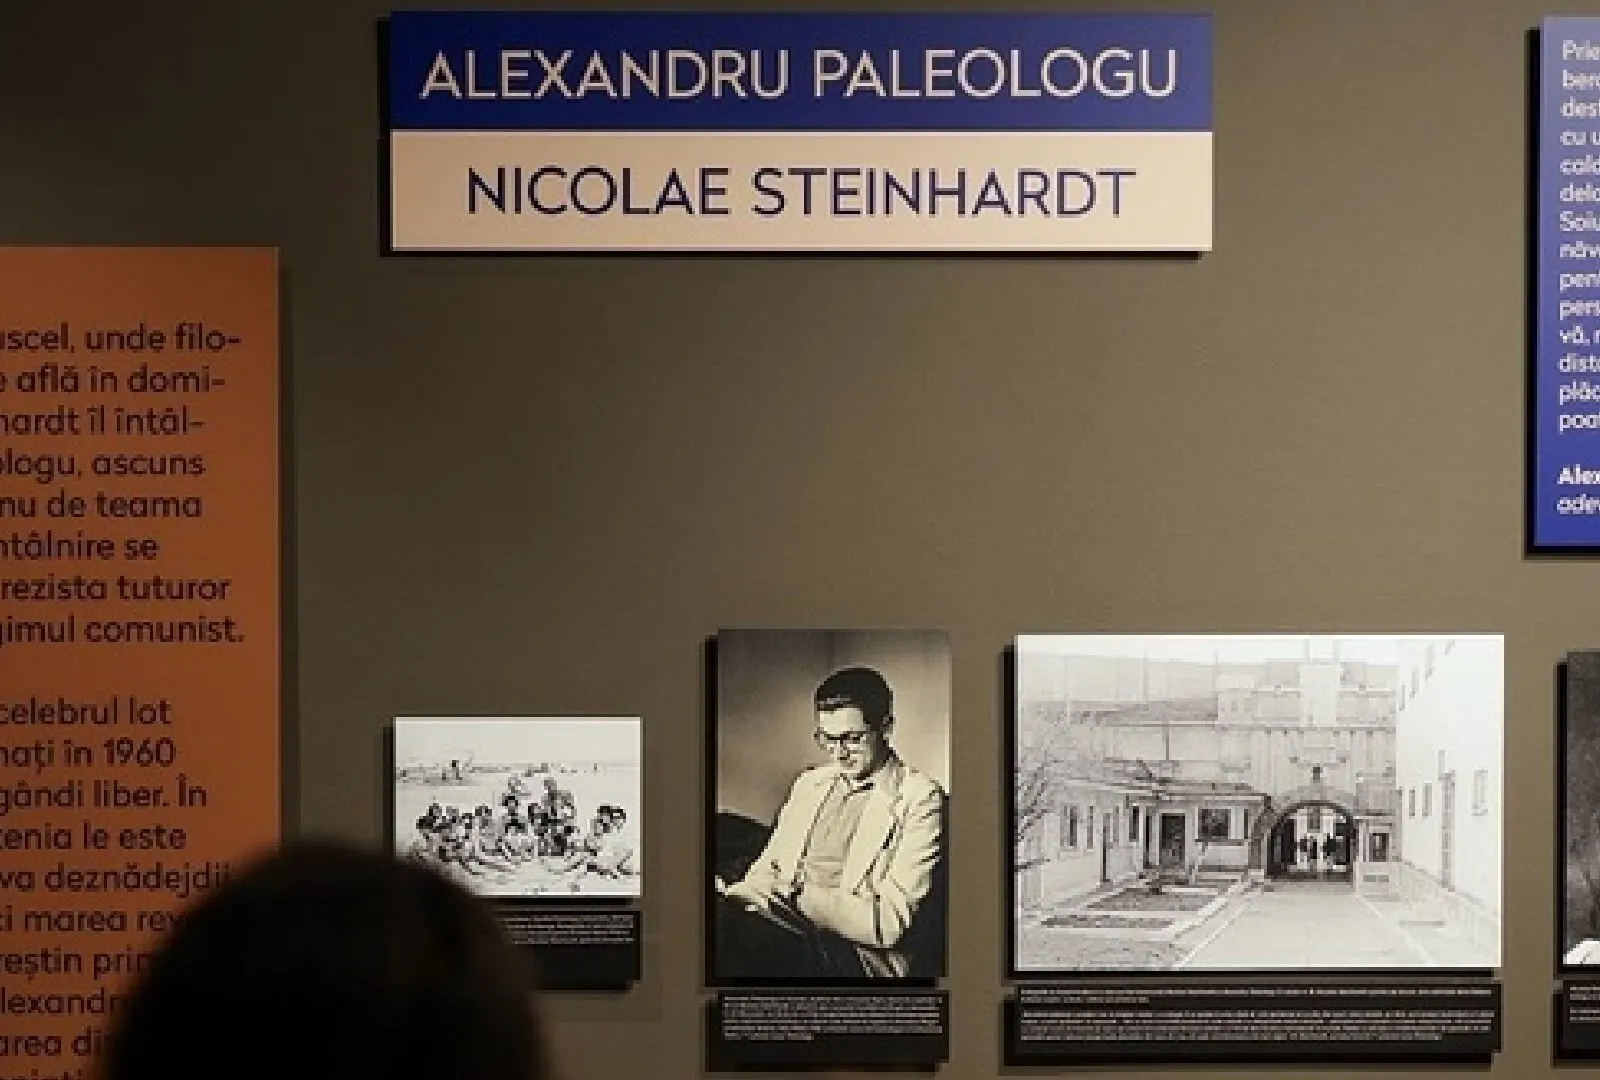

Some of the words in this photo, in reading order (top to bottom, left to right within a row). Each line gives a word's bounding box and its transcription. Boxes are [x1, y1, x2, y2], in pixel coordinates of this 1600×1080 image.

[419, 49, 789, 99] ALEXANDRU
[814, 48, 1177, 97] PALEOLOGU
[468, 166, 734, 215] NICOLAE
[752, 166, 1136, 216] STEINHARDT
[86, 322, 165, 350] unde
[175, 320, 241, 350] filo-
[17, 362, 78, 393] află
[87, 365, 117, 392] în
[127, 361, 225, 392] domi-
[87, 404, 104, 435] îl
[114, 406, 206, 435] întâl-
[0, 448, 81, 484] logu,
[91, 454, 206, 476] ascuns
[0, 497, 35, 517] nu
[46, 486, 86, 517] de
[96, 490, 201, 517] teama
[124, 538, 159, 560] se
[2, 573, 107, 601] rezista
[116, 575, 232, 600] tuturor
[0, 613, 74, 647] imul
[84, 615, 246, 642] comunist.
[129, 696, 173, 724] lot
[63, 739, 93, 767] în
[103, 736, 177, 767] 1960
[93, 779, 170, 807] liber.
[178, 772, 207, 806] În
[0, 822, 71, 849] enia
[83, 819, 110, 849] le
[119, 825, 187, 849] este
[24, 911, 127, 932] marea
[0, 948, 81, 982] eștin
[0, 987, 129, 1015] lexandr
[72, 1026, 112, 1057] di
